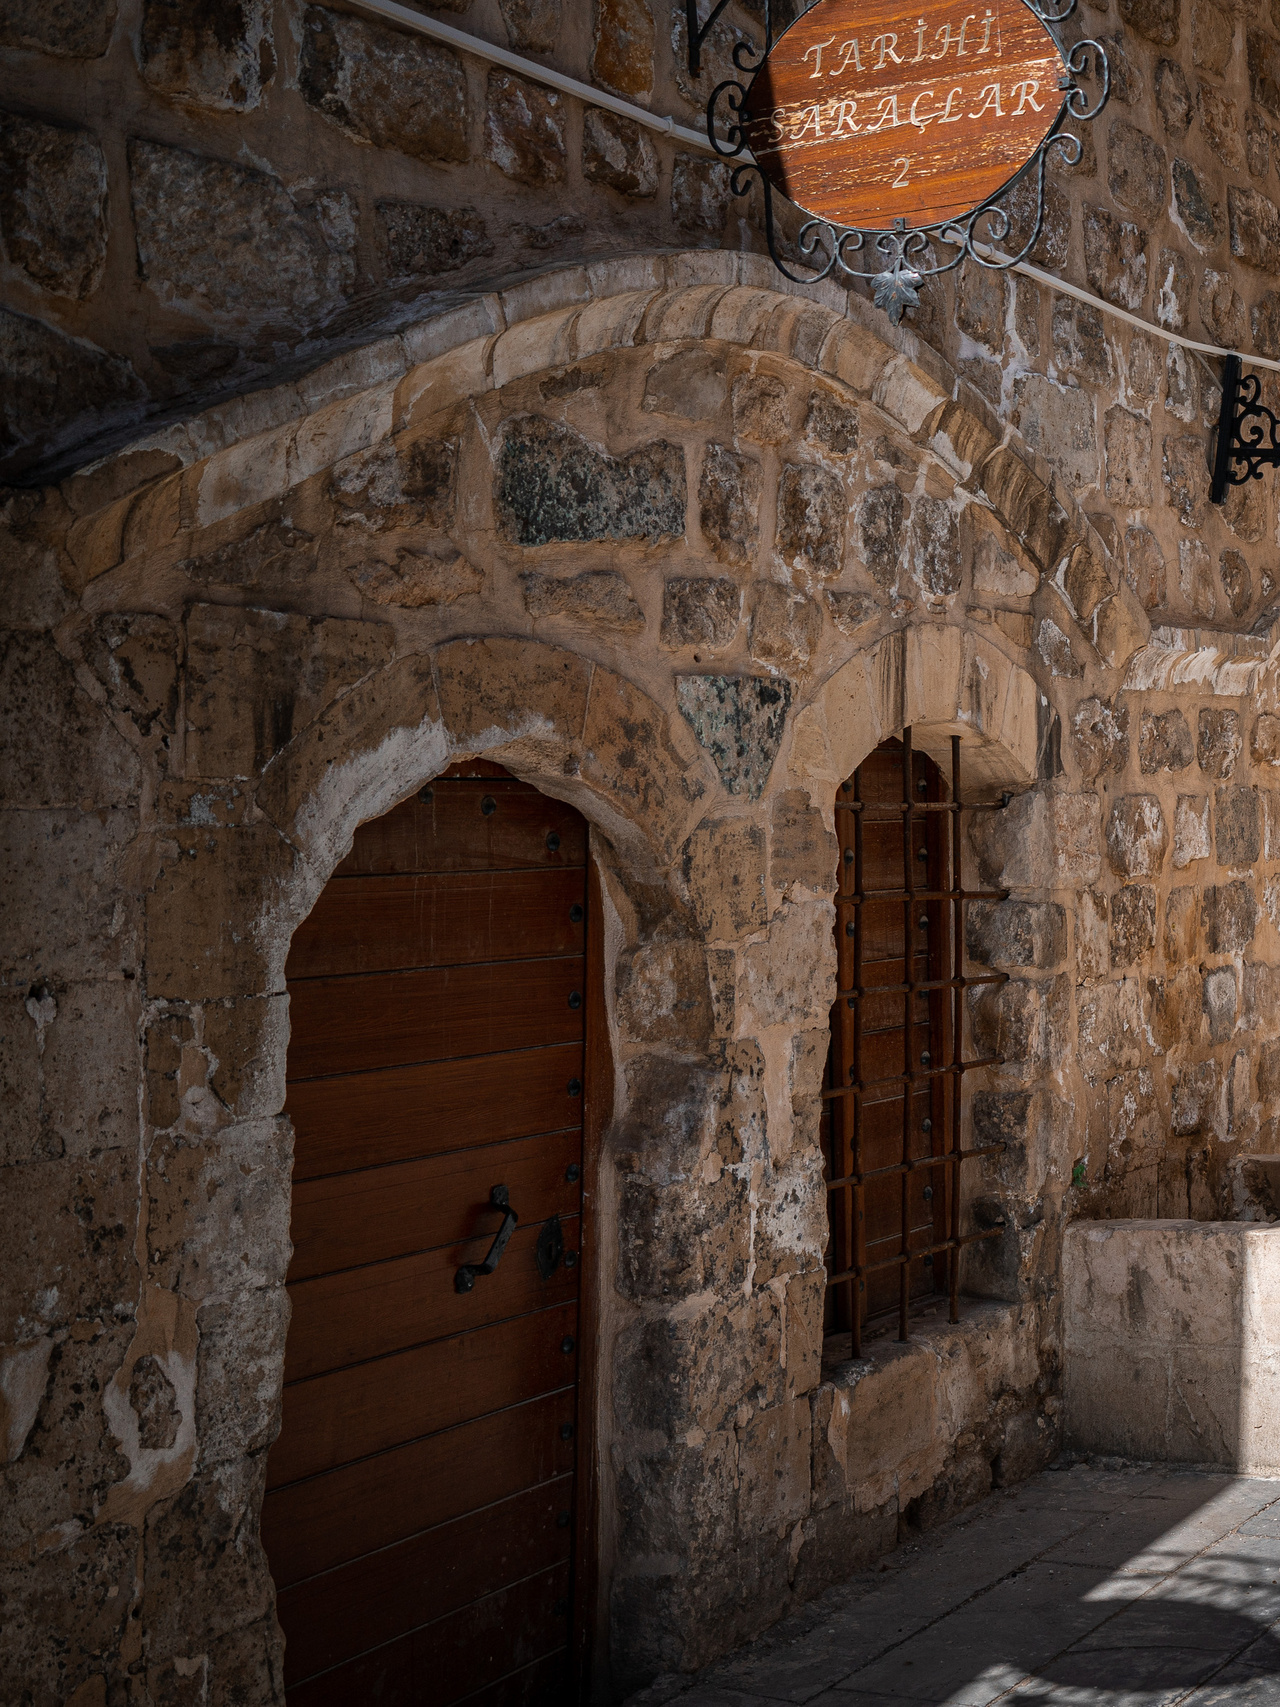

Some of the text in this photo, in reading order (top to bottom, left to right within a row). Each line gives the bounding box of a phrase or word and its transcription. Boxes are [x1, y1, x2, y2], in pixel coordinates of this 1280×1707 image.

[803, 9, 998, 79] TARİHİ
[768, 79, 1046, 142] SARAÇLAR
[891, 157, 911, 189] 2
